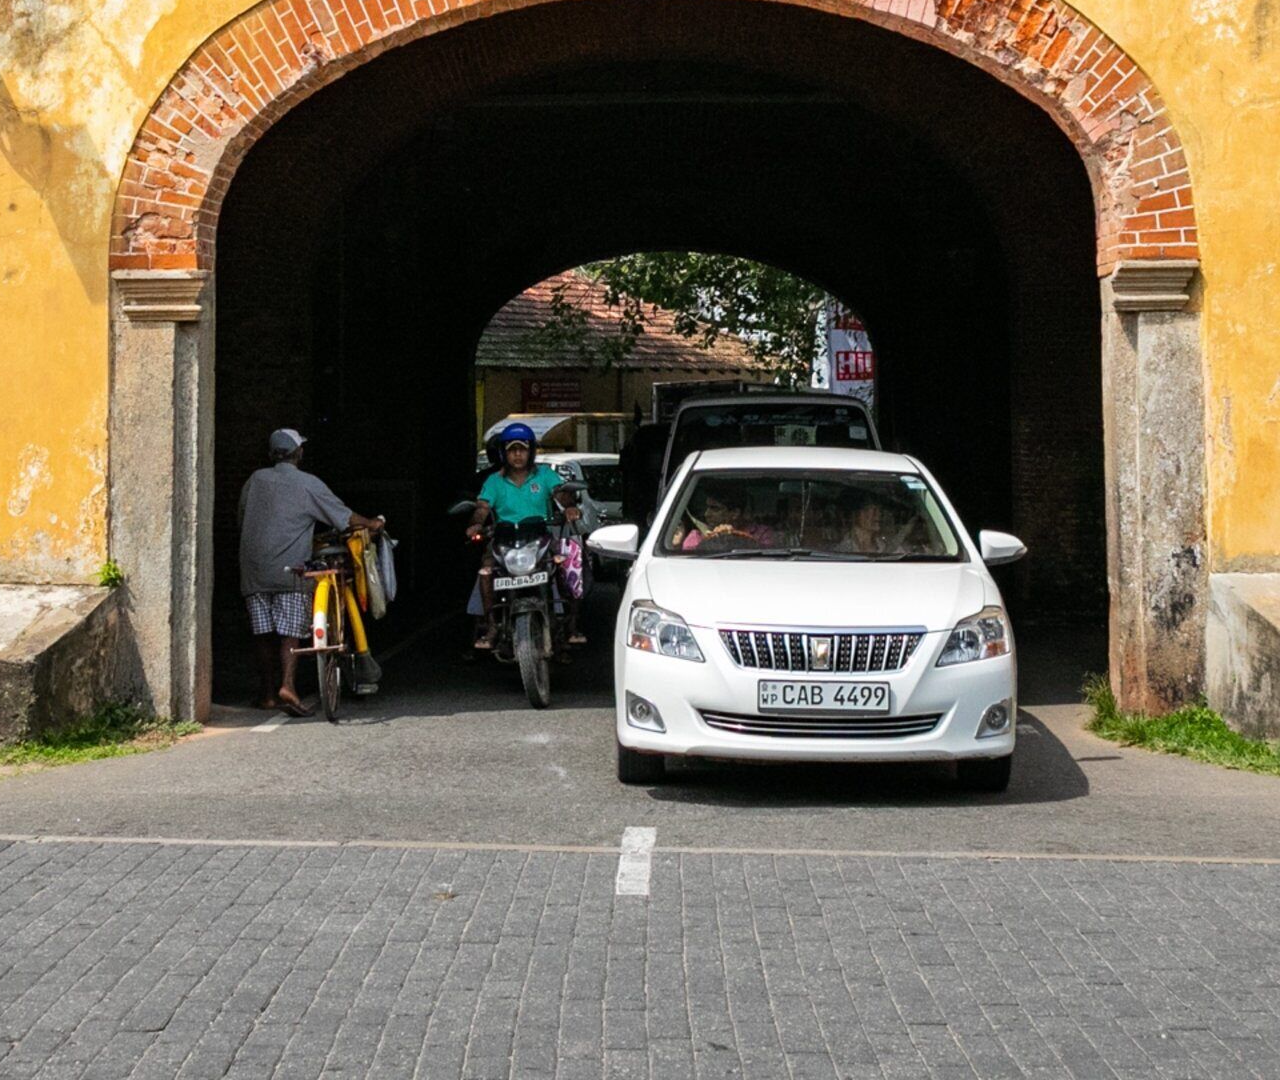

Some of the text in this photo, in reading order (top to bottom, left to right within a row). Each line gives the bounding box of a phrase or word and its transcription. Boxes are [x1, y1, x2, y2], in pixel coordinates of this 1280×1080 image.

[762, 694, 778, 704] WP
[782, 685, 887, 706] CAB 4499
